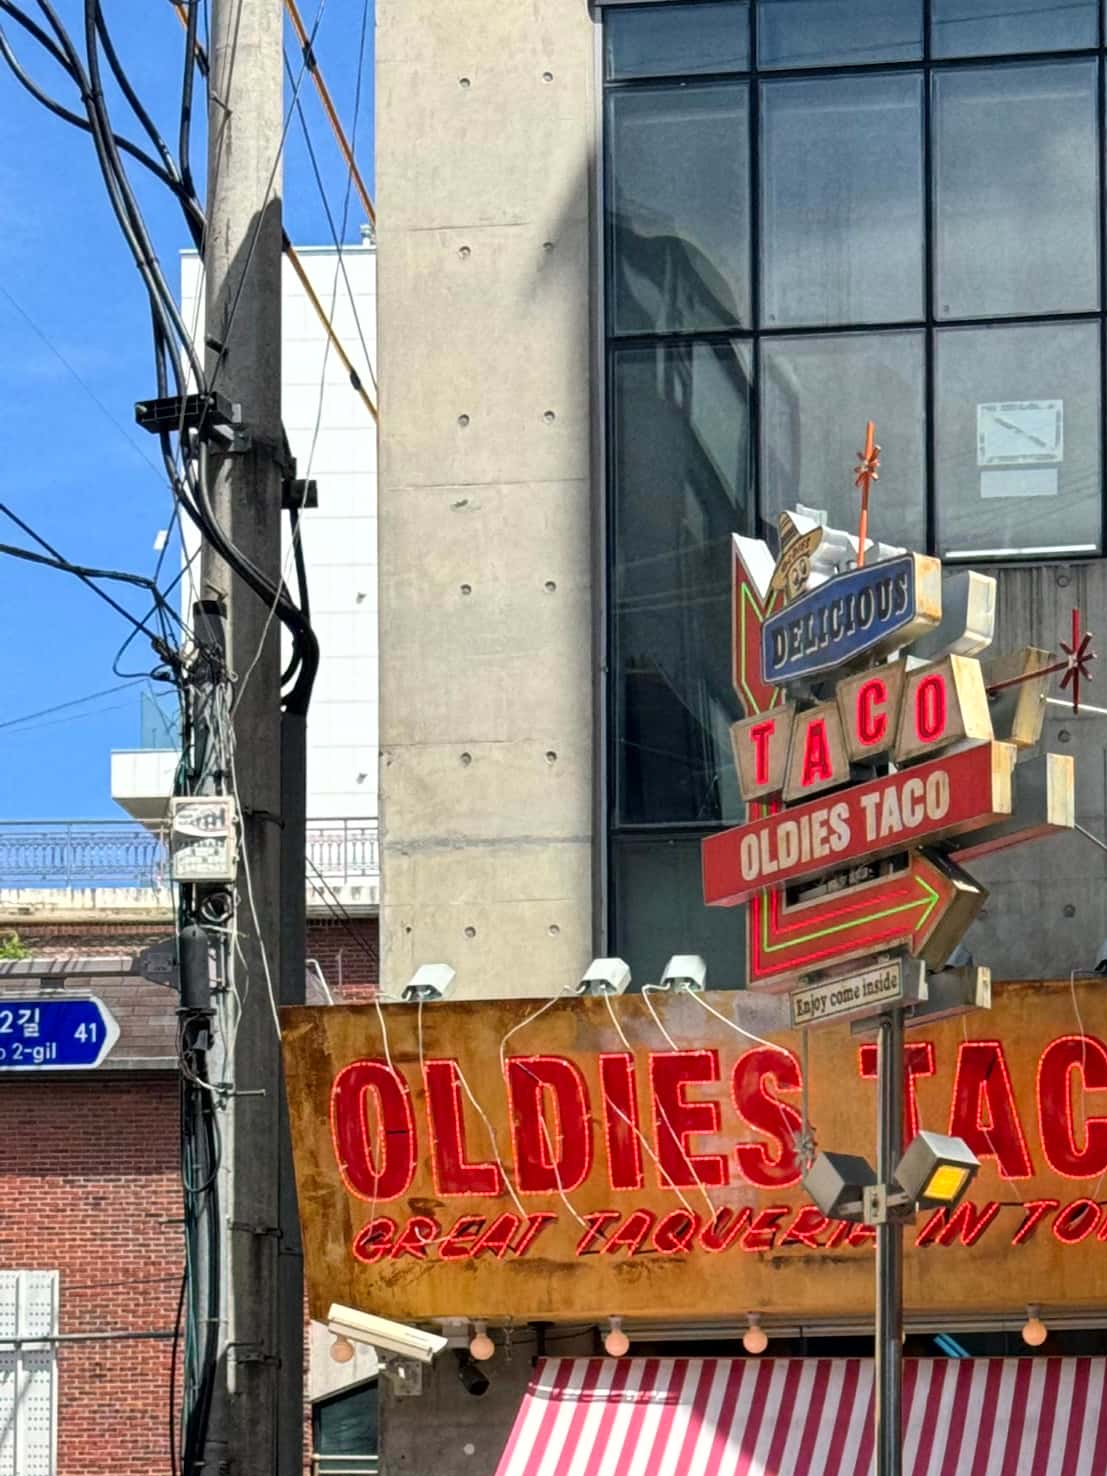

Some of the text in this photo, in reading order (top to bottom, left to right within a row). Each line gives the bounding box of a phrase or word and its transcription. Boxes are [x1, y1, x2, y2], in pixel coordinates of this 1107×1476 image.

[772, 572, 909, 670] DELICIOUS
[750, 673, 948, 788] TACO
[740, 770, 950, 881] OLDIES TACO
[73, 1022, 97, 1043] 41
[796, 970, 898, 1017] Enjoy come inside
[12, 1041, 57, 1063] 2-gil
[330, 1044, 804, 1203] OLDIES
[352, 1210, 558, 1265] GREAT
[915, 1200, 998, 1248] IN
